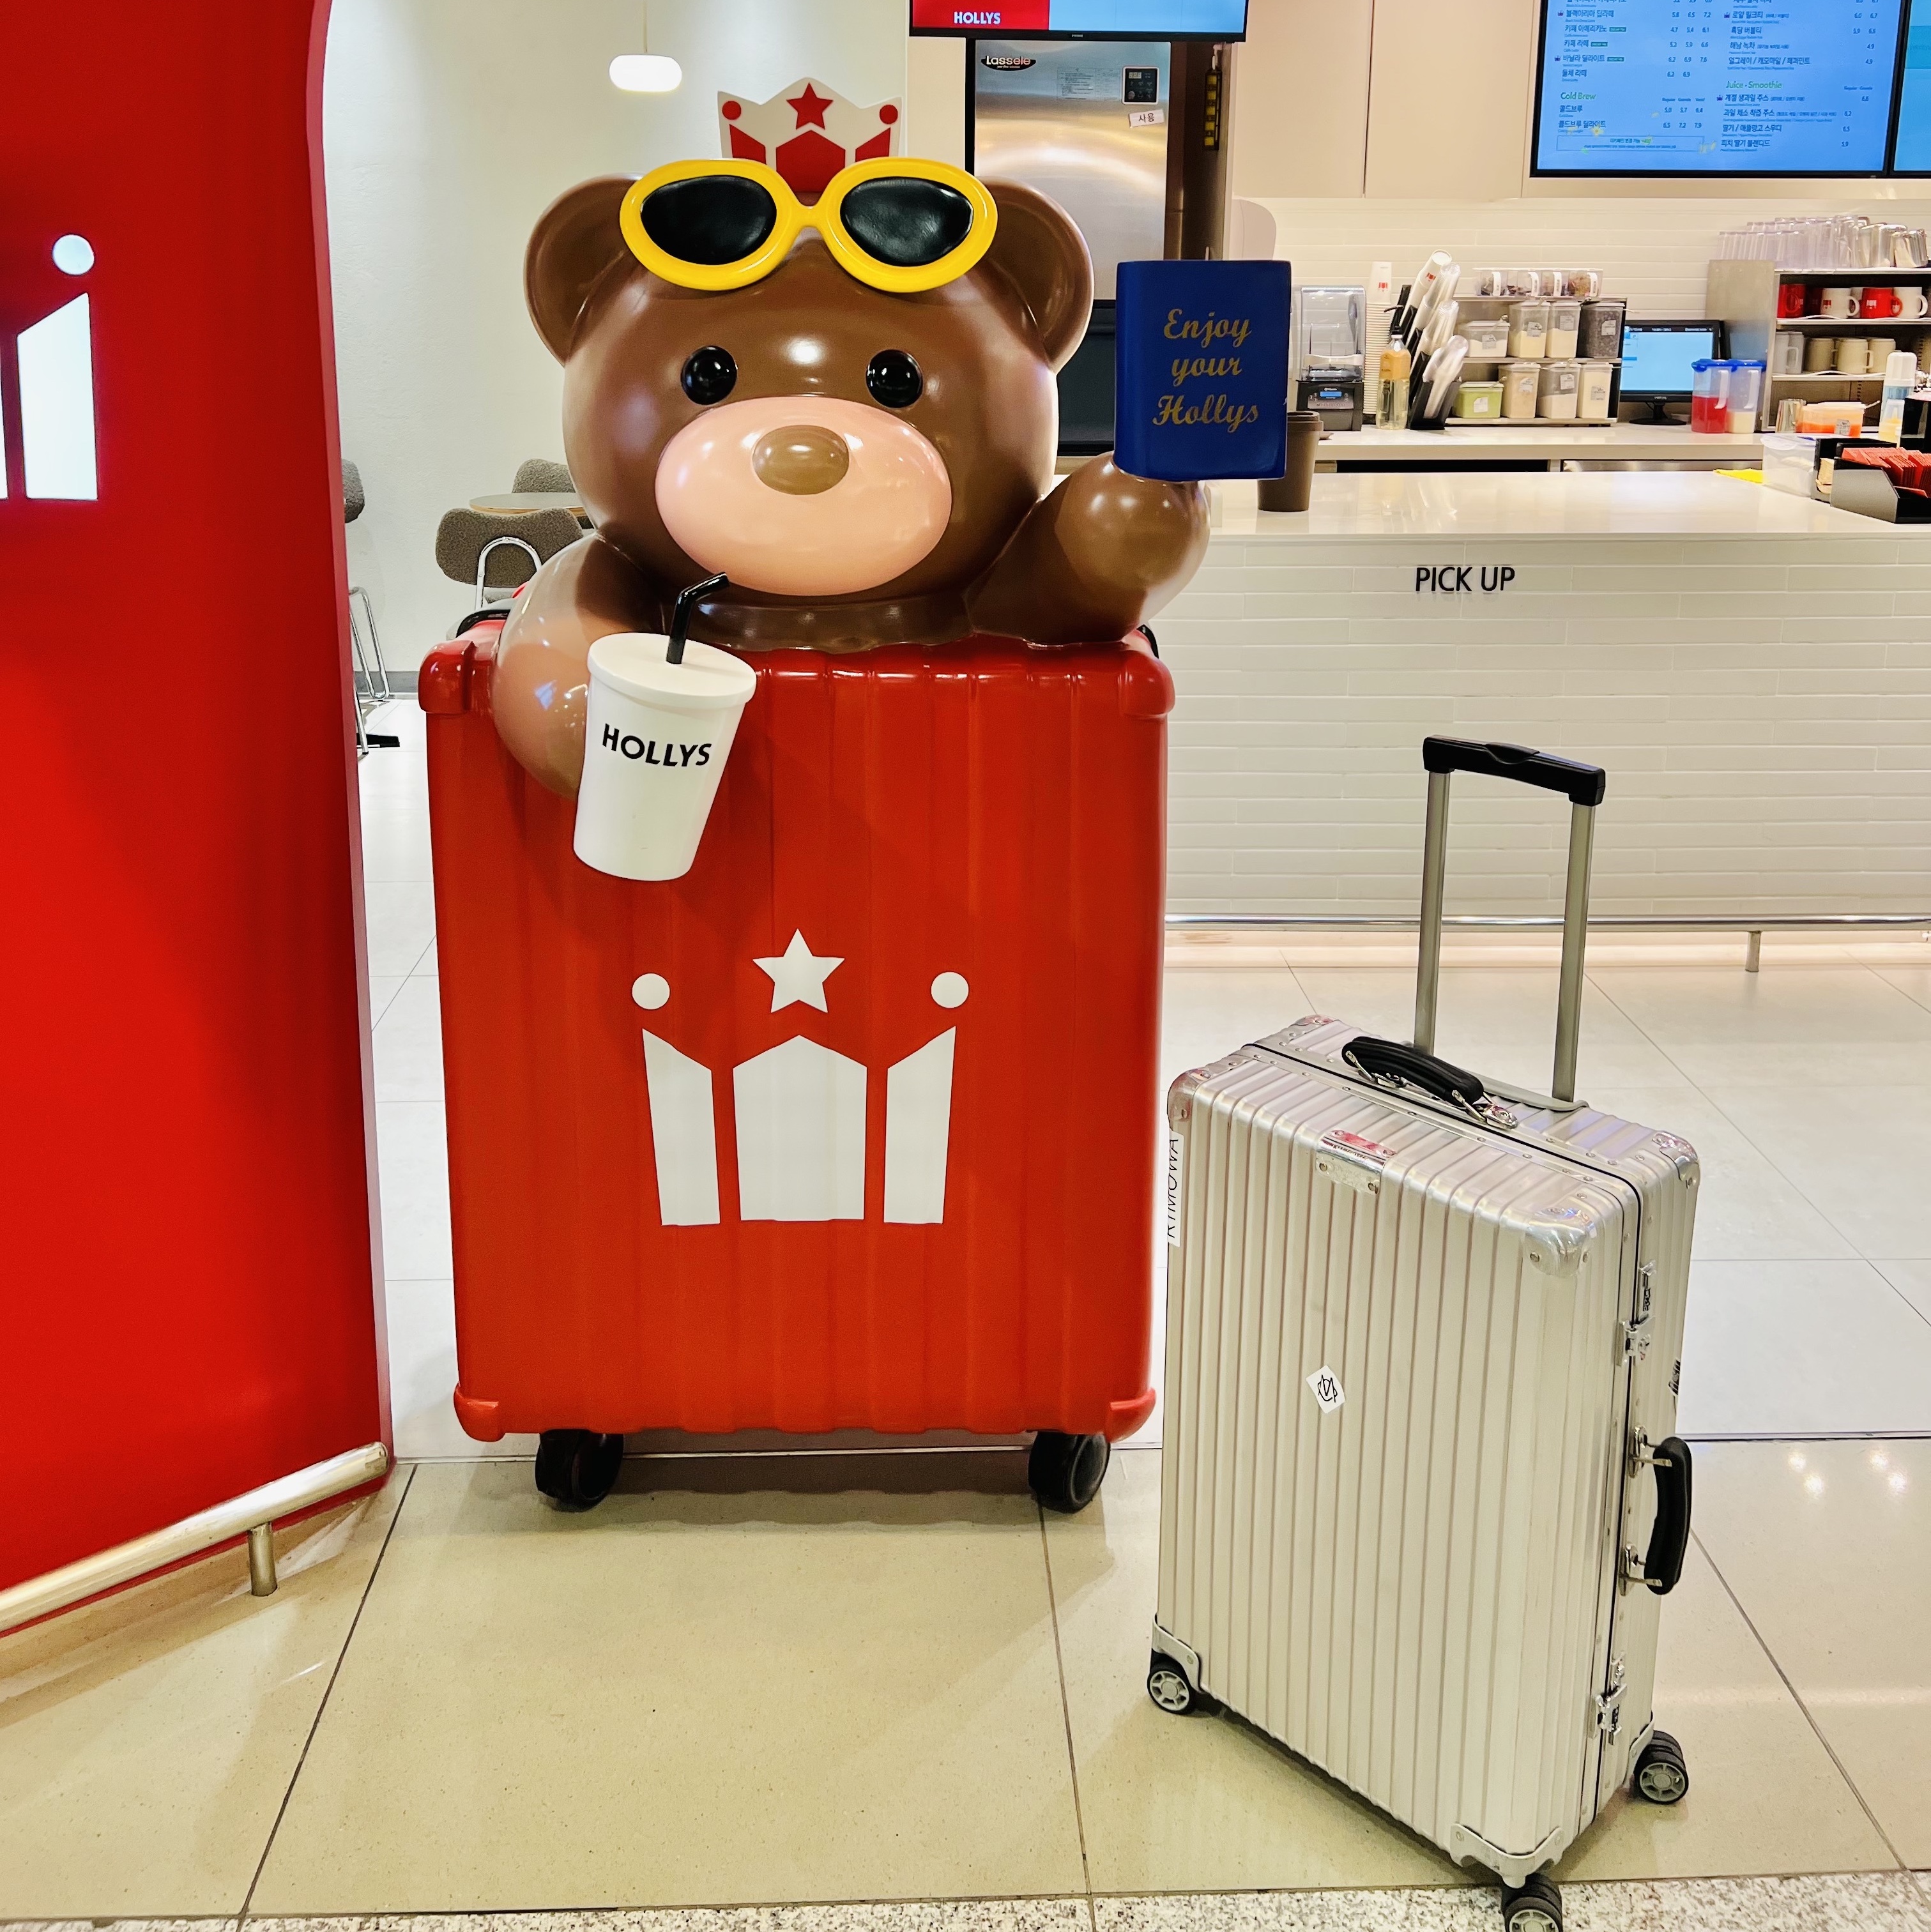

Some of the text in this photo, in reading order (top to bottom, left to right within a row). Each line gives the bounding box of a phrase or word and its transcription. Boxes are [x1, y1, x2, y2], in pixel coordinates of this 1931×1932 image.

[954, 11, 1001, 24] HOLLYS
[986, 55, 1031, 65] Lassele
[1726, 80, 1744, 89] Juice
[1748, 80, 1782, 89] Smoothie
[1138, 113, 1155, 123] 사용
[1763, 109, 1775, 117] 주스
[1764, 124, 1782, 132] 스무디
[1163, 308, 1252, 348] Enjoy
[1171, 357, 1242, 387] your
[1152, 394, 1260, 433] Hollys
[1415, 567, 1515, 592] PICK UP
[602, 723, 712, 767] HOLLYS
